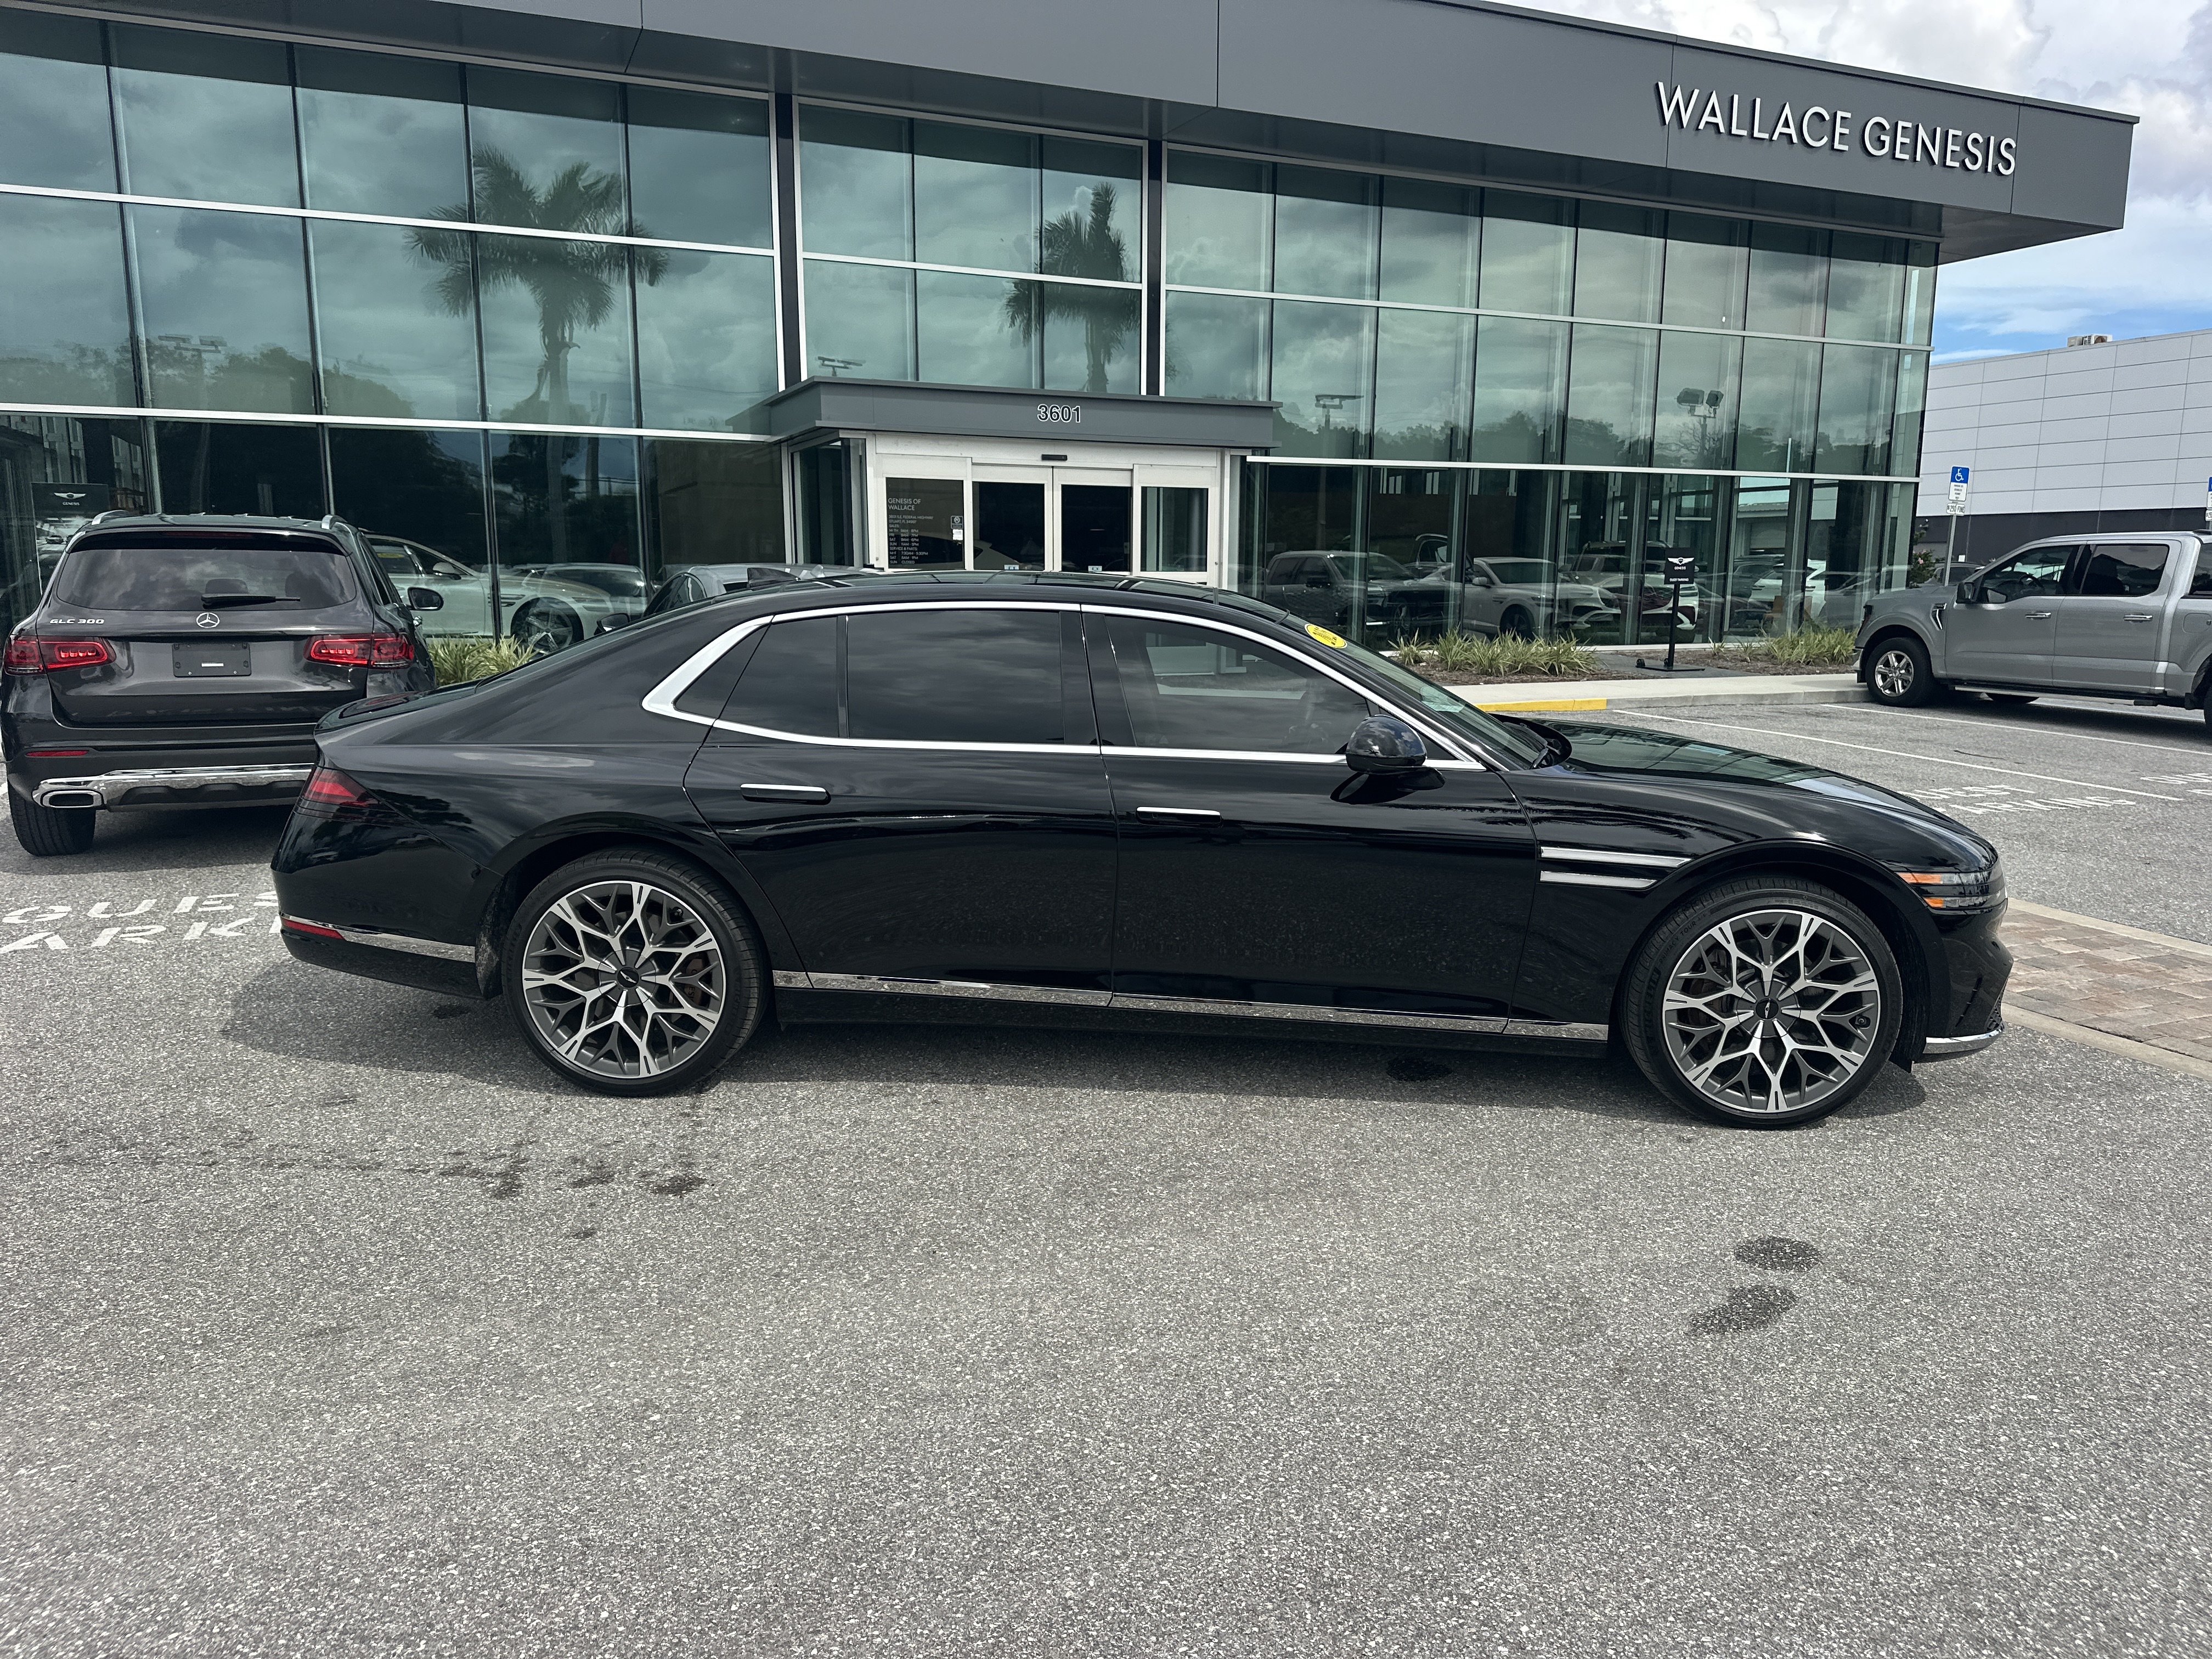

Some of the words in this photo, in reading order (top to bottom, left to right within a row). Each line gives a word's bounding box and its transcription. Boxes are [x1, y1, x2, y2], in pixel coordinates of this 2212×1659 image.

[1656, 81, 1852, 152] WALLACE
[1864, 116, 2017, 176] GENESIS
[1037, 404, 1080, 422] 3601
[1659, 936, 1679, 964] PRIMACY
[1680, 921, 1697, 936] TOUR
